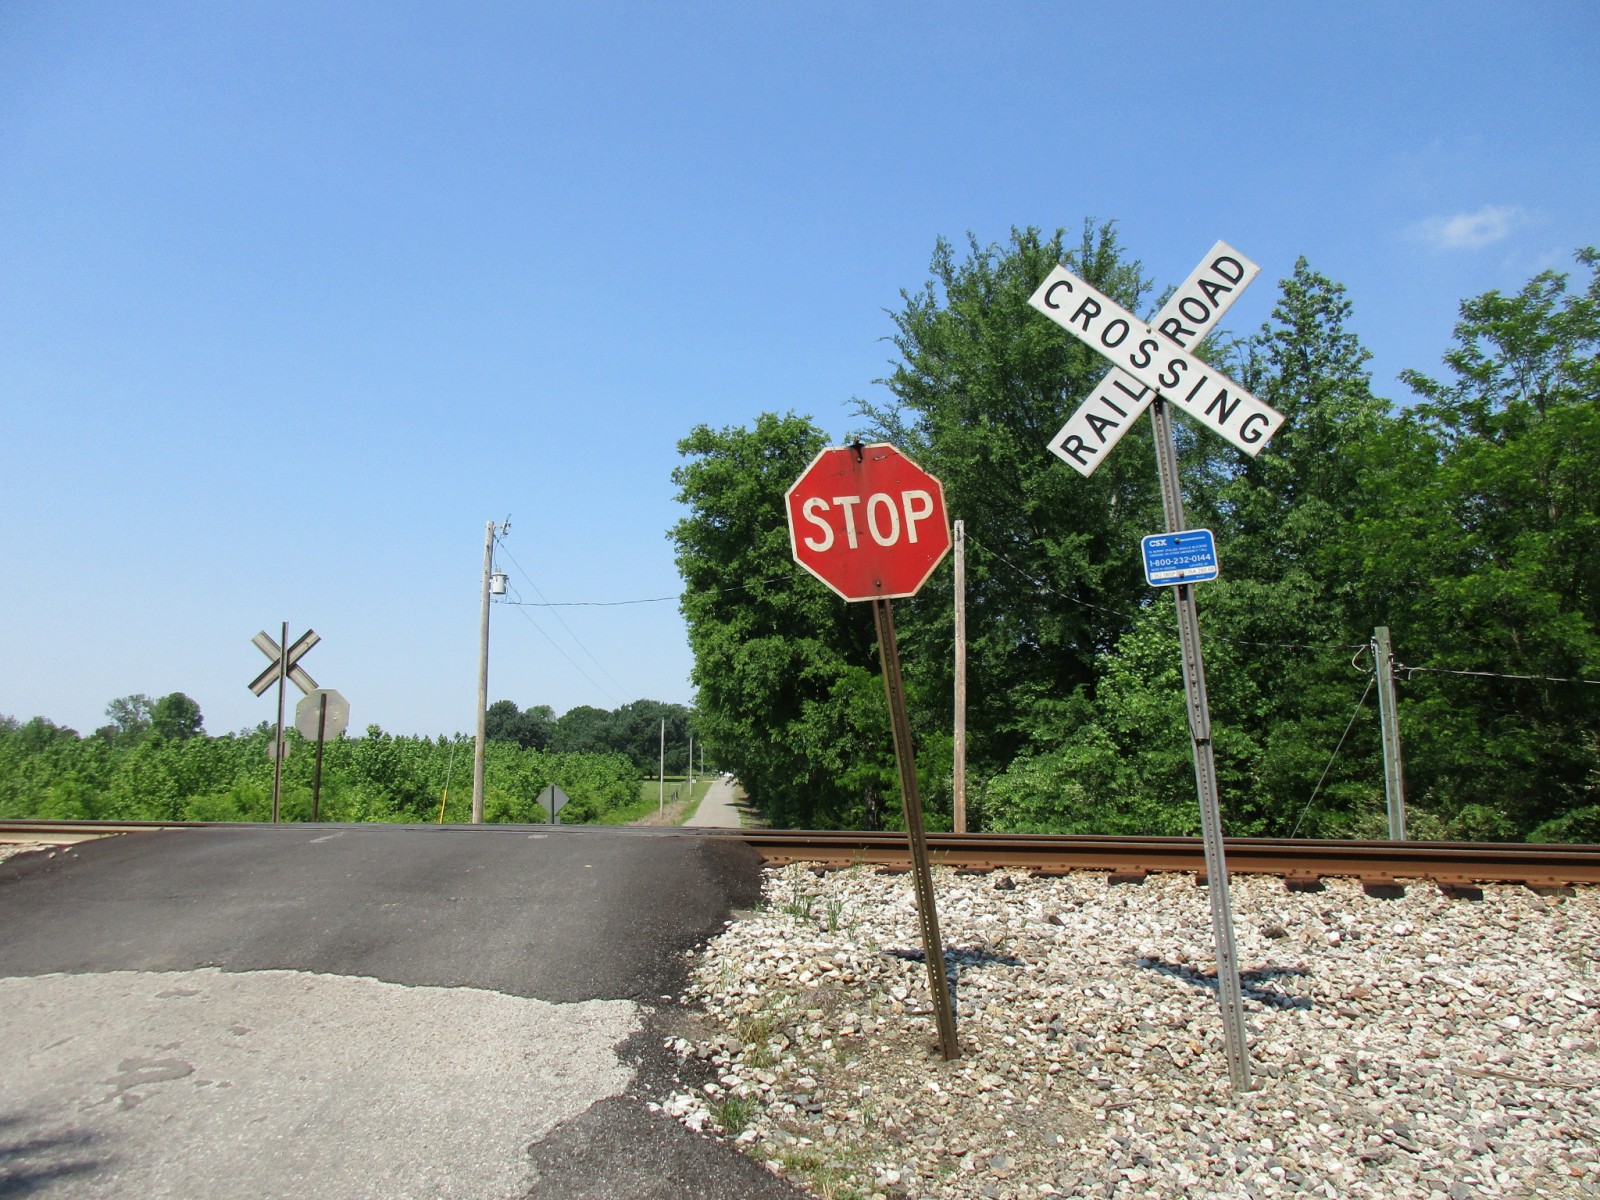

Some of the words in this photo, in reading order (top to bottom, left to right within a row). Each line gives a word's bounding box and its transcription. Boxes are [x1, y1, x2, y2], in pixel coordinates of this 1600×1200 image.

[1043, 280, 1270, 444] CROSSING
[1059, 380, 1150, 467] RAIL
[1158, 256, 1245, 348] ROAD
[802, 489, 934, 552] STOP
[1149, 539, 1167, 548] CSX
[1149, 553, 1211, 567] 1-800-232-0144
